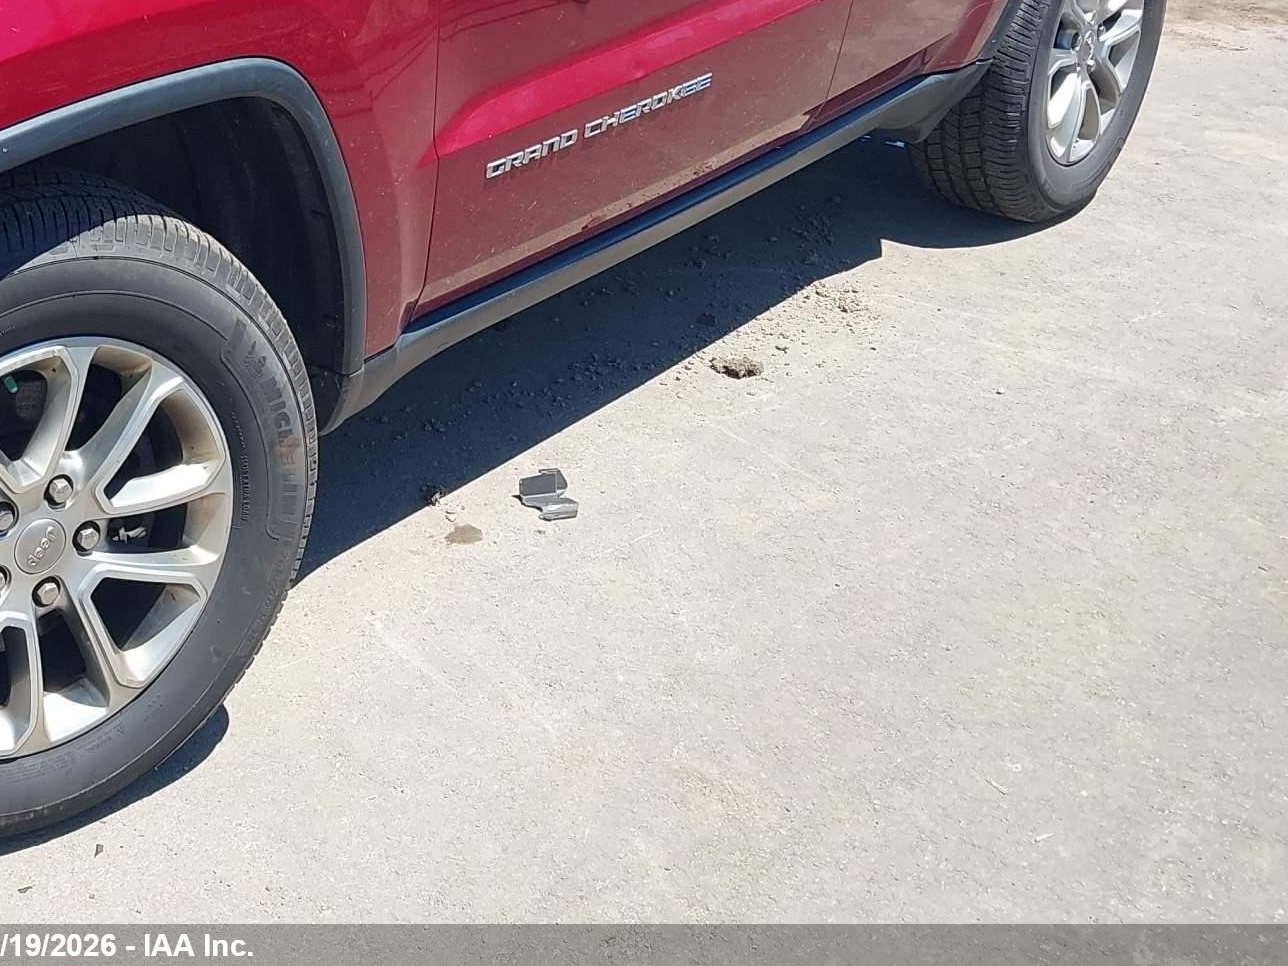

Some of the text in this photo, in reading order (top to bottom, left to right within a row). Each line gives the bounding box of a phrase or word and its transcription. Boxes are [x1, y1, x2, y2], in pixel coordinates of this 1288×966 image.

[485, 72, 713, 180] GRAND CHEROKEE
[26, 525, 58, 567] Jeep
